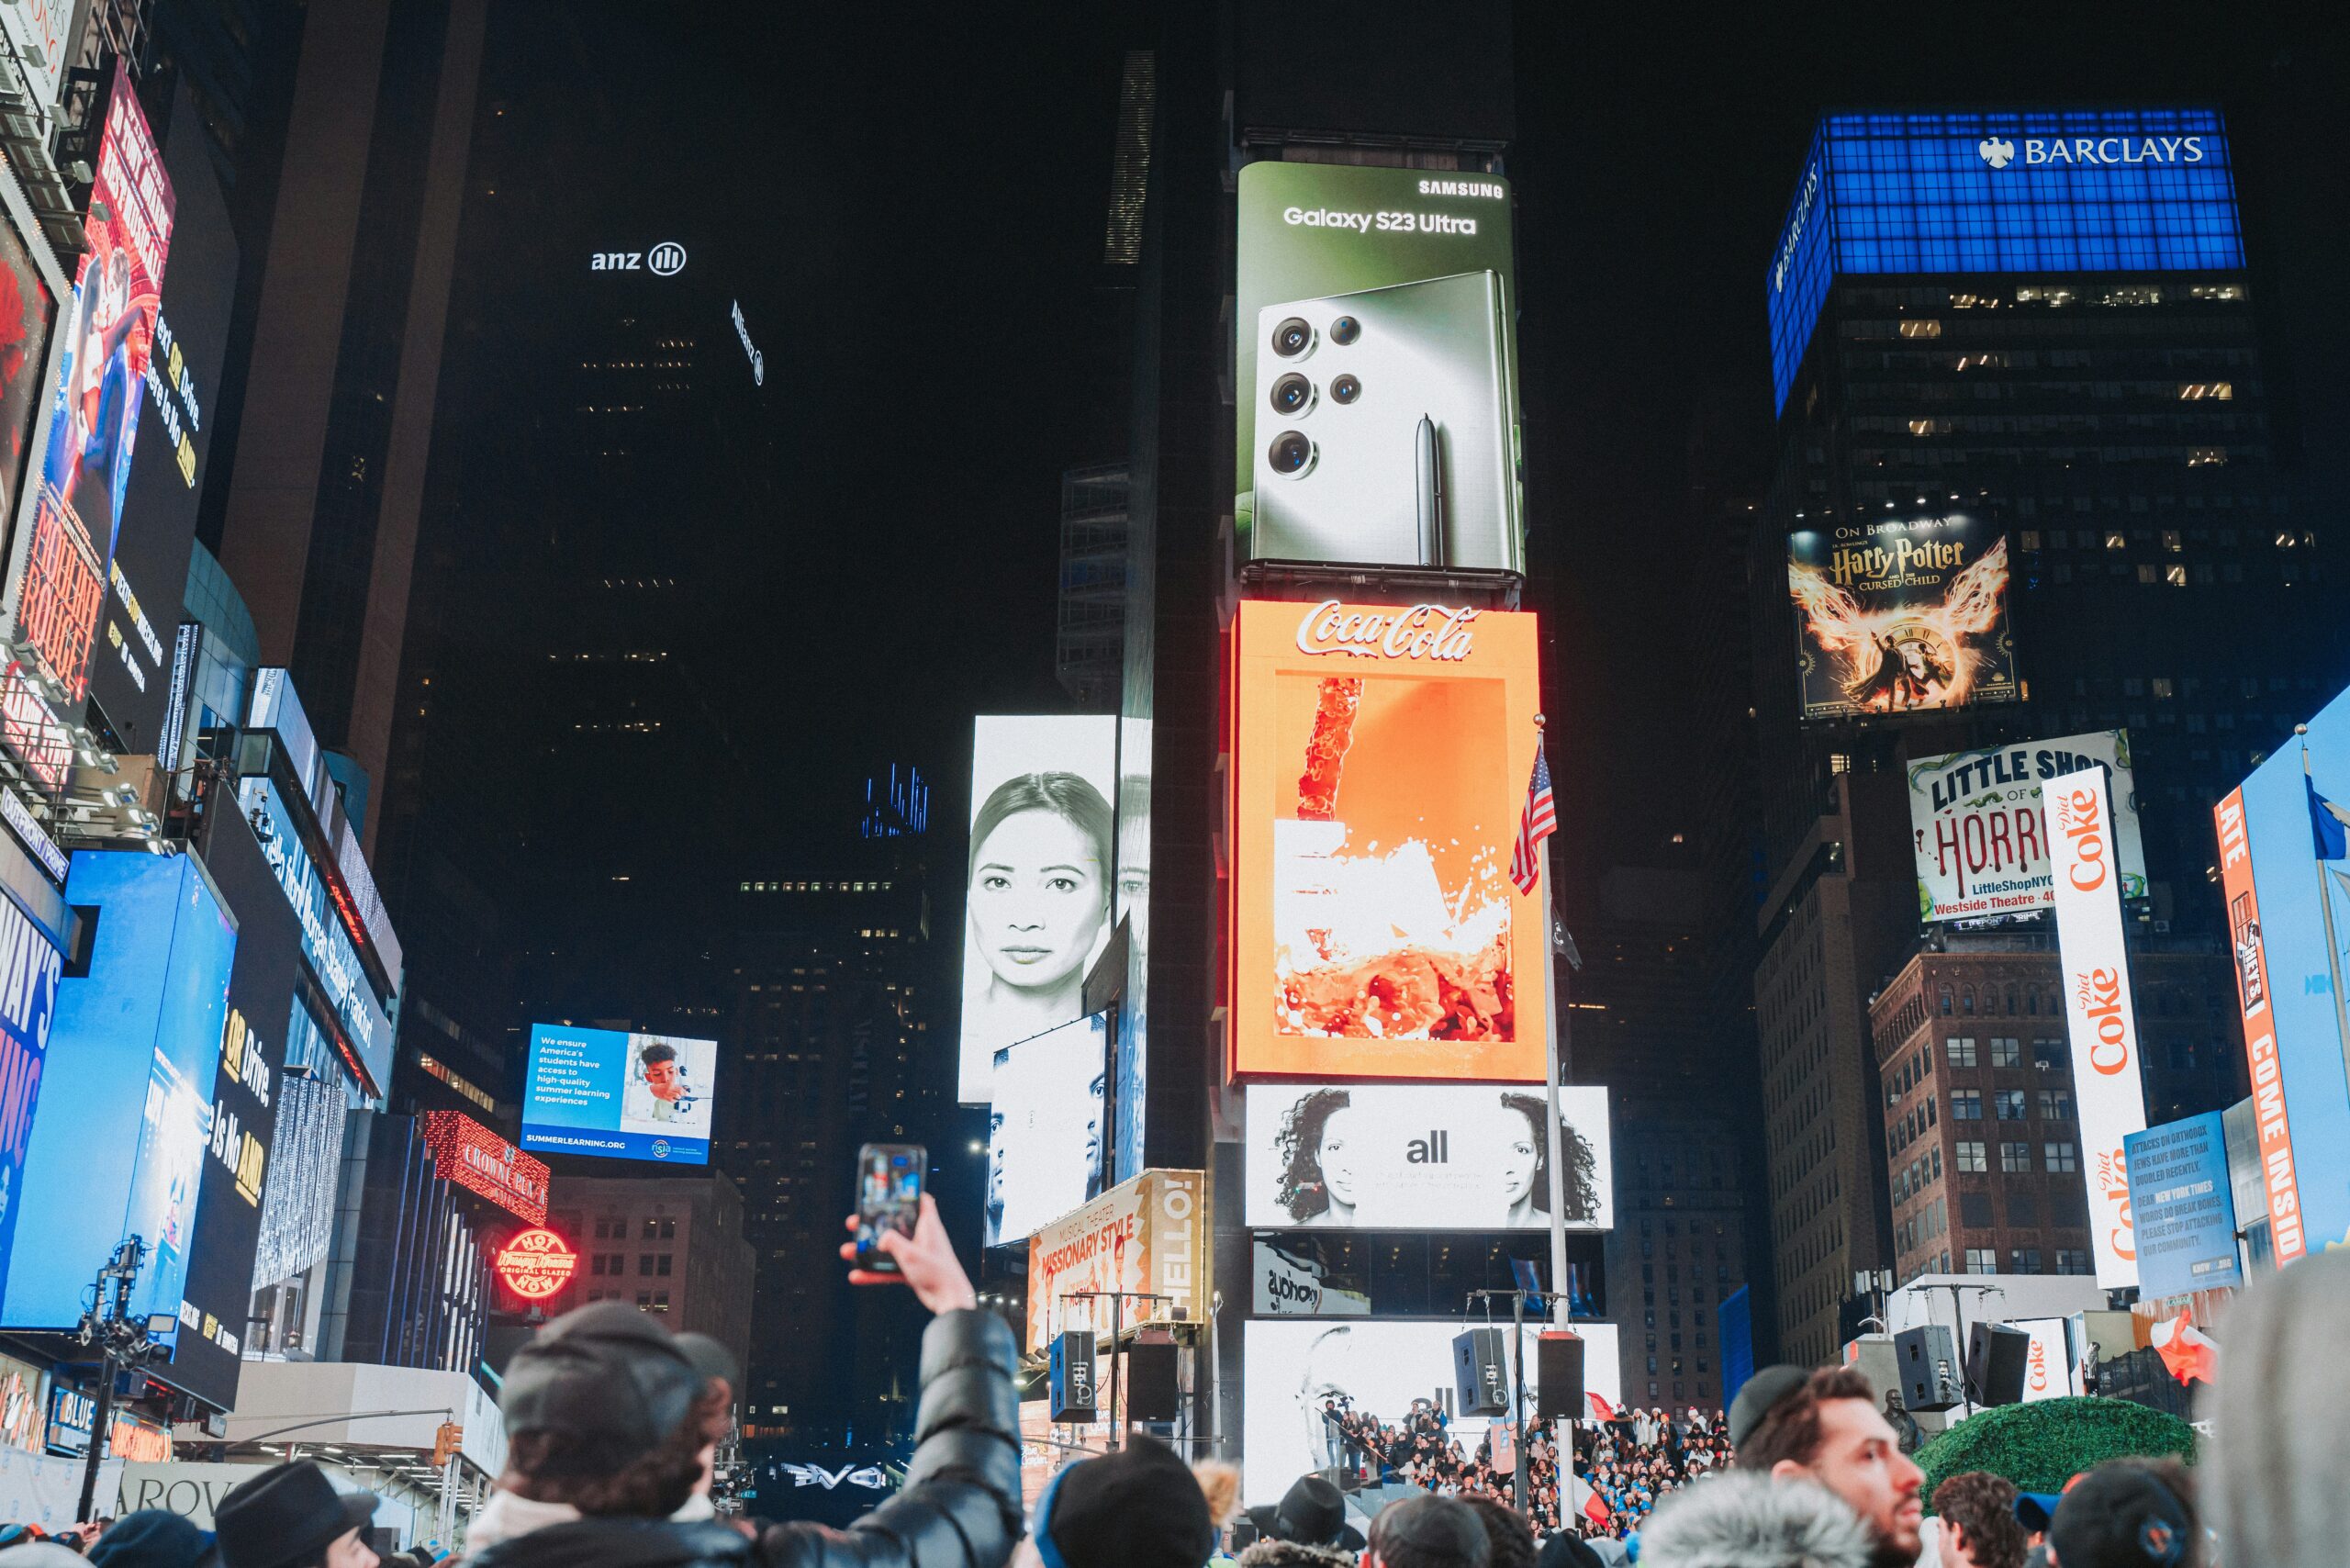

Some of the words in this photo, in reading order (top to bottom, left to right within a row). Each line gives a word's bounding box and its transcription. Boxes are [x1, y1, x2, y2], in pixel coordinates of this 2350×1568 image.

[111, 95, 124, 136] 10
[2025, 136, 2204, 164] BARCLAYS
[102, 140, 128, 211] BEST
[1419, 180, 1504, 199] SAMSUNG
[1283, 207, 1372, 233] Galaxy
[1375, 211, 1416, 231] S23
[1419, 213, 1477, 235] Ultra
[1783, 162, 1818, 274] BARCLAYS
[591, 252, 642, 271] anz
[732, 298, 755, 364] Allianz
[168, 342, 183, 390] OR
[179, 365, 200, 432] Drive.
[162, 388, 172, 425] Is
[168, 405, 181, 448] No
[1836, 527, 1861, 540] ON
[1866, 517, 1953, 536] BROADWAY
[32, 498, 98, 633] MOULIN
[1829, 545, 1895, 587] Harry
[1895, 538, 1964, 584] Potter
[1859, 579, 1902, 591] CURSED
[1905, 575, 1941, 587] CHILD
[1295, 599, 1483, 662] Coca-Cola
[1931, 750, 2030, 813] LITTLE
[2035, 749, 2113, 781] SHOP
[2007, 789, 2027, 801] OF
[5, 792, 45, 853] OUTFRONT
[44, 843, 67, 879] PRIME
[2058, 795, 2071, 831] Diet
[2066, 787, 2107, 892] Coke
[1935, 807, 2051, 900] HORR
[1934, 900, 1987, 916] Westside
[1990, 894, 2035, 909] Theatre
[0, 892, 62, 1051] WAY'S
[301, 889, 329, 965] Morgan
[326, 943, 350, 1016] Stanley
[346, 978, 373, 1048] Frankfurt
[2078, 971, 2093, 1012] Diet
[2087, 965, 2129, 1077] Coke
[539, 1047, 584, 1058] America's
[541, 1036, 555, 1046] We
[556, 1039, 588, 1048] ensure
[223, 1008, 246, 1084] OR
[241, 1027, 270, 1108] Drive.
[538, 1056, 578, 1067] students
[579, 1058, 600, 1069] have
[538, 1067, 567, 1076] access
[536, 1085, 573, 1095] summer
[574, 1088, 610, 1100] learning
[537, 1074, 591, 1088] high-quality
[2252, 1033, 2286, 1144] COME
[0, 1027, 41, 1170] ING
[534, 1094, 588, 1106] experiences
[212, 1099, 226, 1160] Is
[223, 1112, 241, 1174] No
[526, 1134, 626, 1149] SUMMERLEARNING.ORG
[652, 1144, 671, 1155] nsla
[1406, 1129, 1448, 1164] all
[2132, 1137, 2160, 1155] ATTACKS
[2160, 1135, 2170, 1147] ON
[2171, 1125, 2208, 1145] ORTHODOX
[2133, 1155, 2152, 1170] JEWS
[2152, 1151, 2170, 1166] HAVE
[2170, 1146, 2189, 1160] MORE
[2190, 1141, 2209, 1157] THAN
[464, 1144, 512, 1189] CROWNE
[515, 1173, 545, 1205] PLAZA
[2096, 1150, 2113, 1197] Diet
[2135, 1170, 2165, 1187] DOUBLED
[2137, 1194, 2155, 1208] DEAR
[2155, 1190, 2173, 1204] NEW
[2173, 1185, 2190, 1200] YORK
[2139, 1209, 2163, 1225] WORDS
[2164, 1208, 2174, 1219] DO
[2174, 1201, 2197, 1216] BREAK
[2198, 1195, 2222, 1211] BONES.
[1058, 1222, 1084, 1243] MUSICAL
[1086, 1204, 1114, 1226] THEATER
[2141, 1226, 2166, 1240] PLEASE
[2166, 1221, 2184, 1235] STOP
[2185, 1213, 2223, 1231] ATTACKING
[521, 1235, 555, 1249] HOT
[1041, 1231, 1100, 1281] MISSIONARY
[1101, 1212, 1135, 1253] STYLE
[1163, 1180, 1192, 1319] HELLO!
[2143, 1244, 2157, 1257] OUR
[2157, 1235, 2201, 1253] COMMUNITY.
[498, 1250, 538, 1270] Krispy
[535, 1253, 576, 1269] Kreme
[500, 1267, 539, 1275] ORIGINAL
[516, 1275, 554, 1293] NOW
[1069, 1280, 1101, 1309] MORMN
[2028, 1339, 2047, 1392] Coke
[64, 1392, 95, 1431] BLUE
